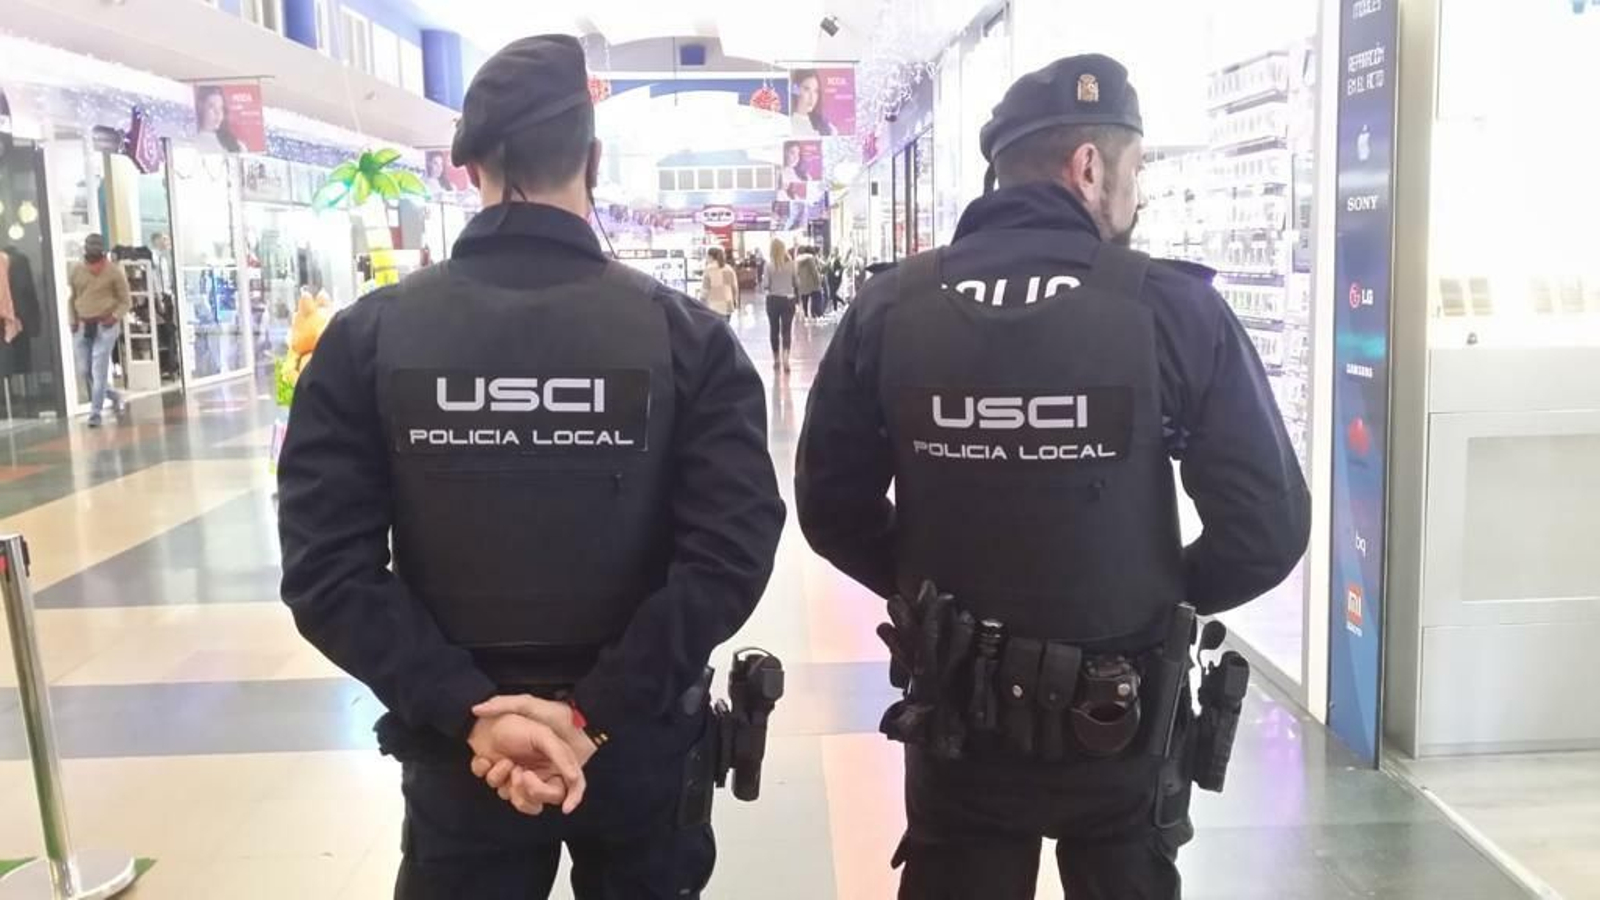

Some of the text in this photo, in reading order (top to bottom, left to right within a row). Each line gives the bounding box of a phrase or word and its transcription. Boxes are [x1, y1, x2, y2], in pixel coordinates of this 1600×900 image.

[1347, 195, 1379, 211] SONY
[436, 377, 605, 413] USCI
[932, 395, 1088, 429] USCI
[409, 429, 634, 445] POLICIA LOCAL
[913, 440, 1117, 460] POLICIA LOCAL
[1355, 530, 1366, 557] bq
